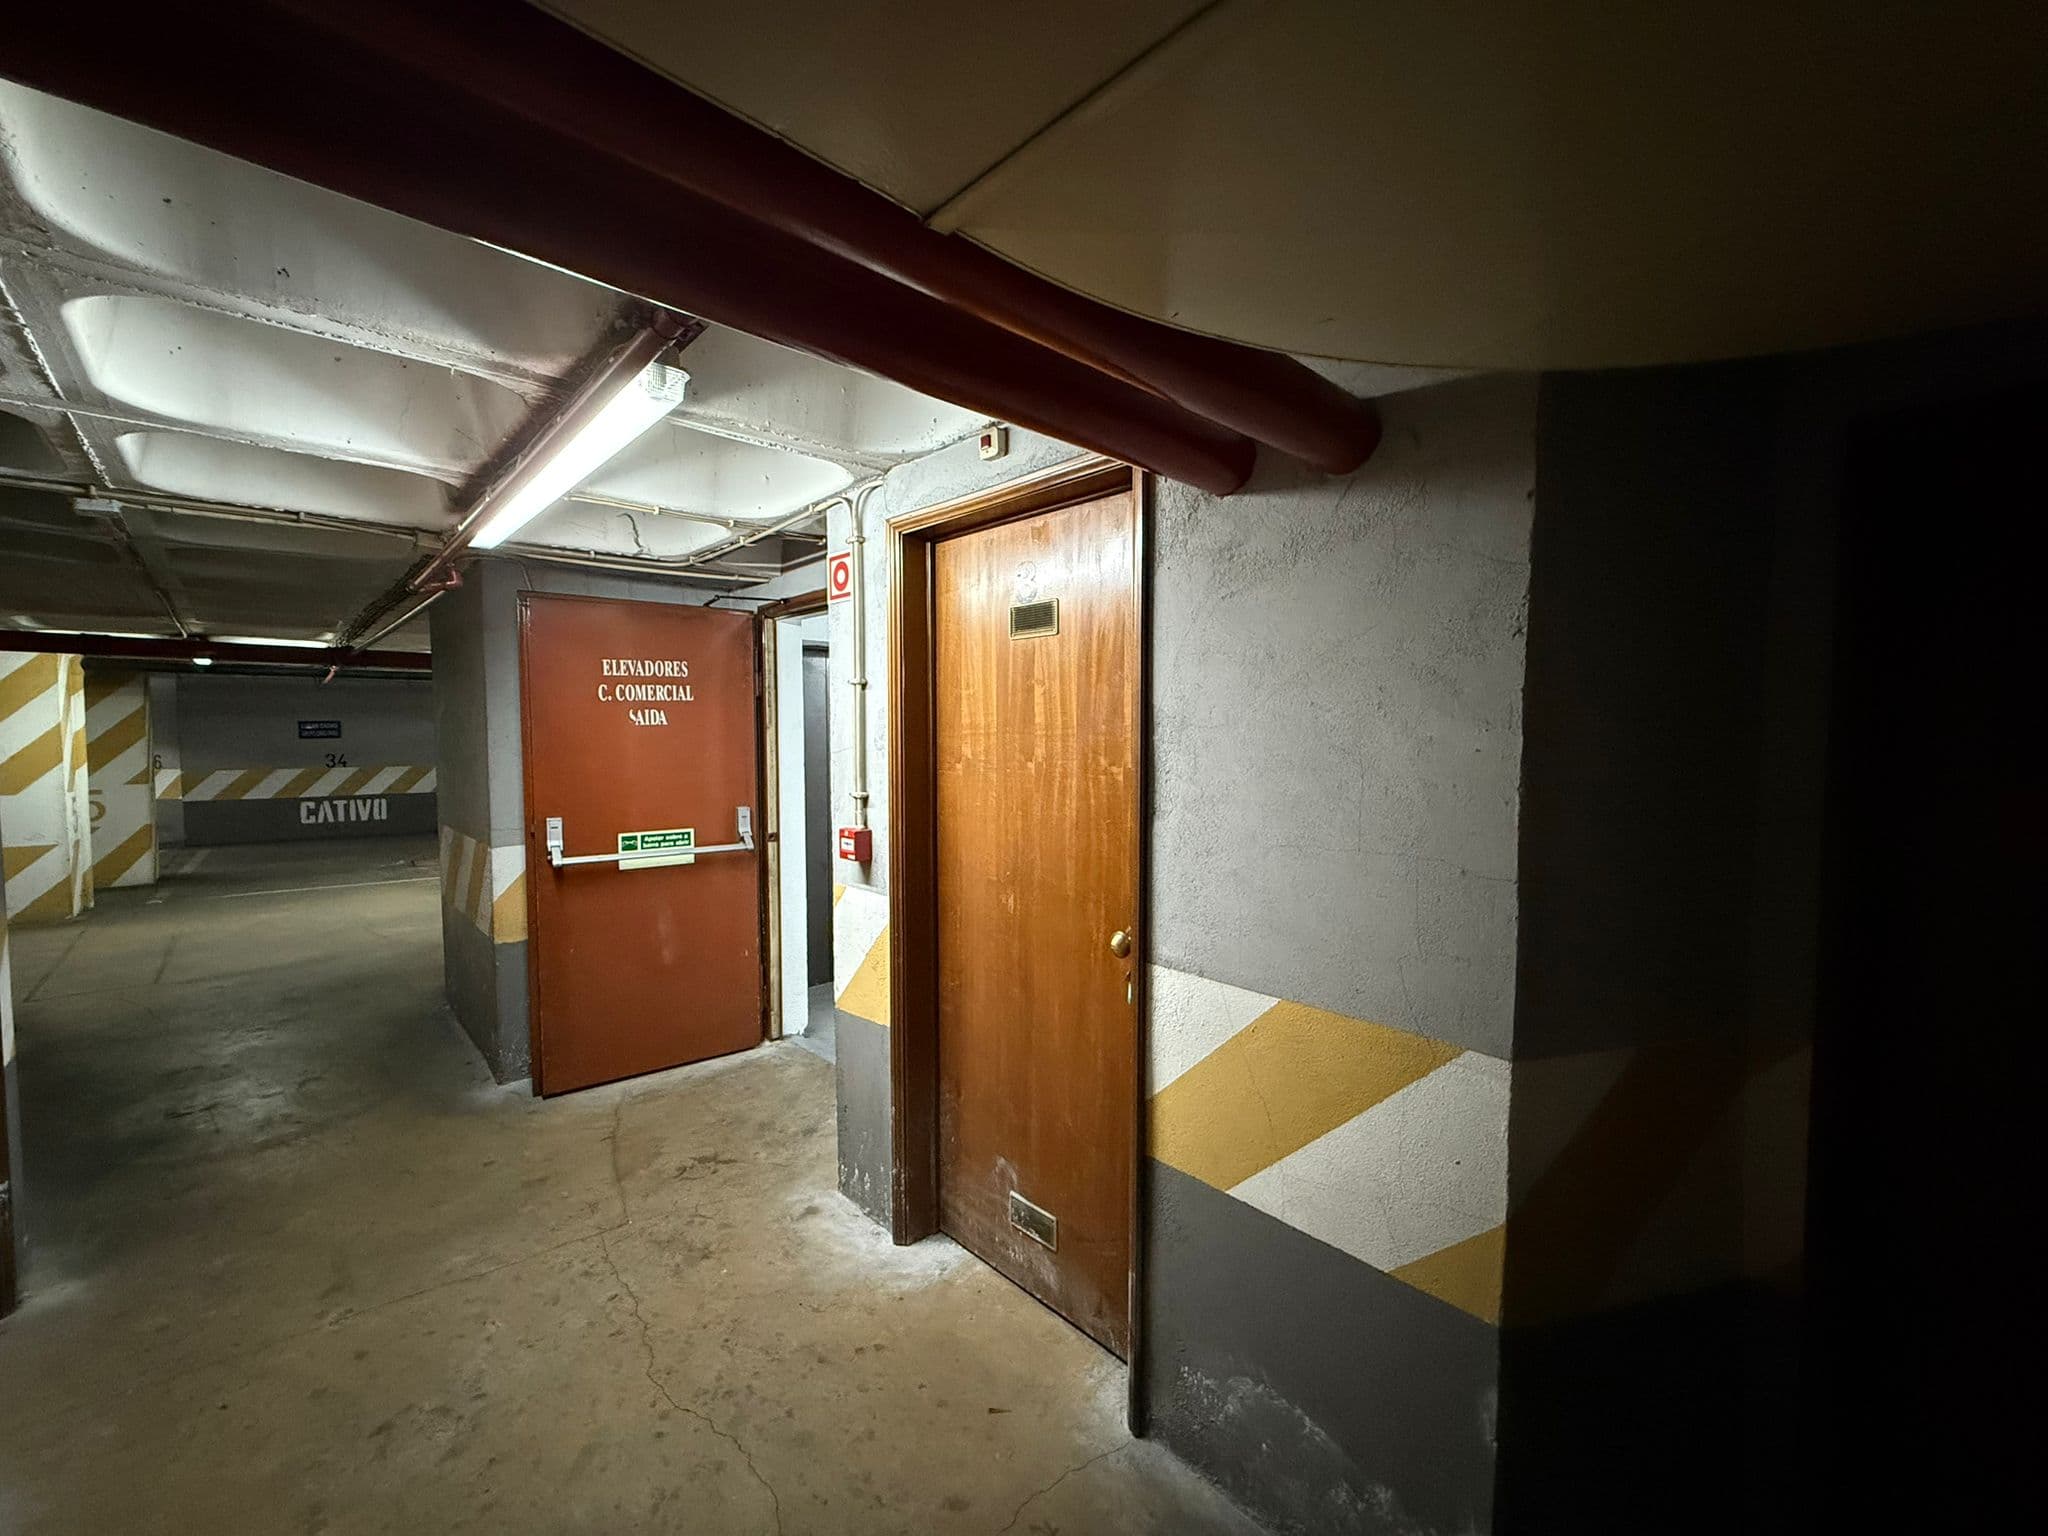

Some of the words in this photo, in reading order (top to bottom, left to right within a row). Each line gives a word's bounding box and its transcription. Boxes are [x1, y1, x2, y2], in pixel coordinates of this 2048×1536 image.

[601, 658, 689, 678] ELEVADORES
[598, 684, 612, 701] C.
[615, 684, 695, 701] COMERCIAL
[325, 753, 347, 768] 34
[300, 798, 388, 824] CATIVO
